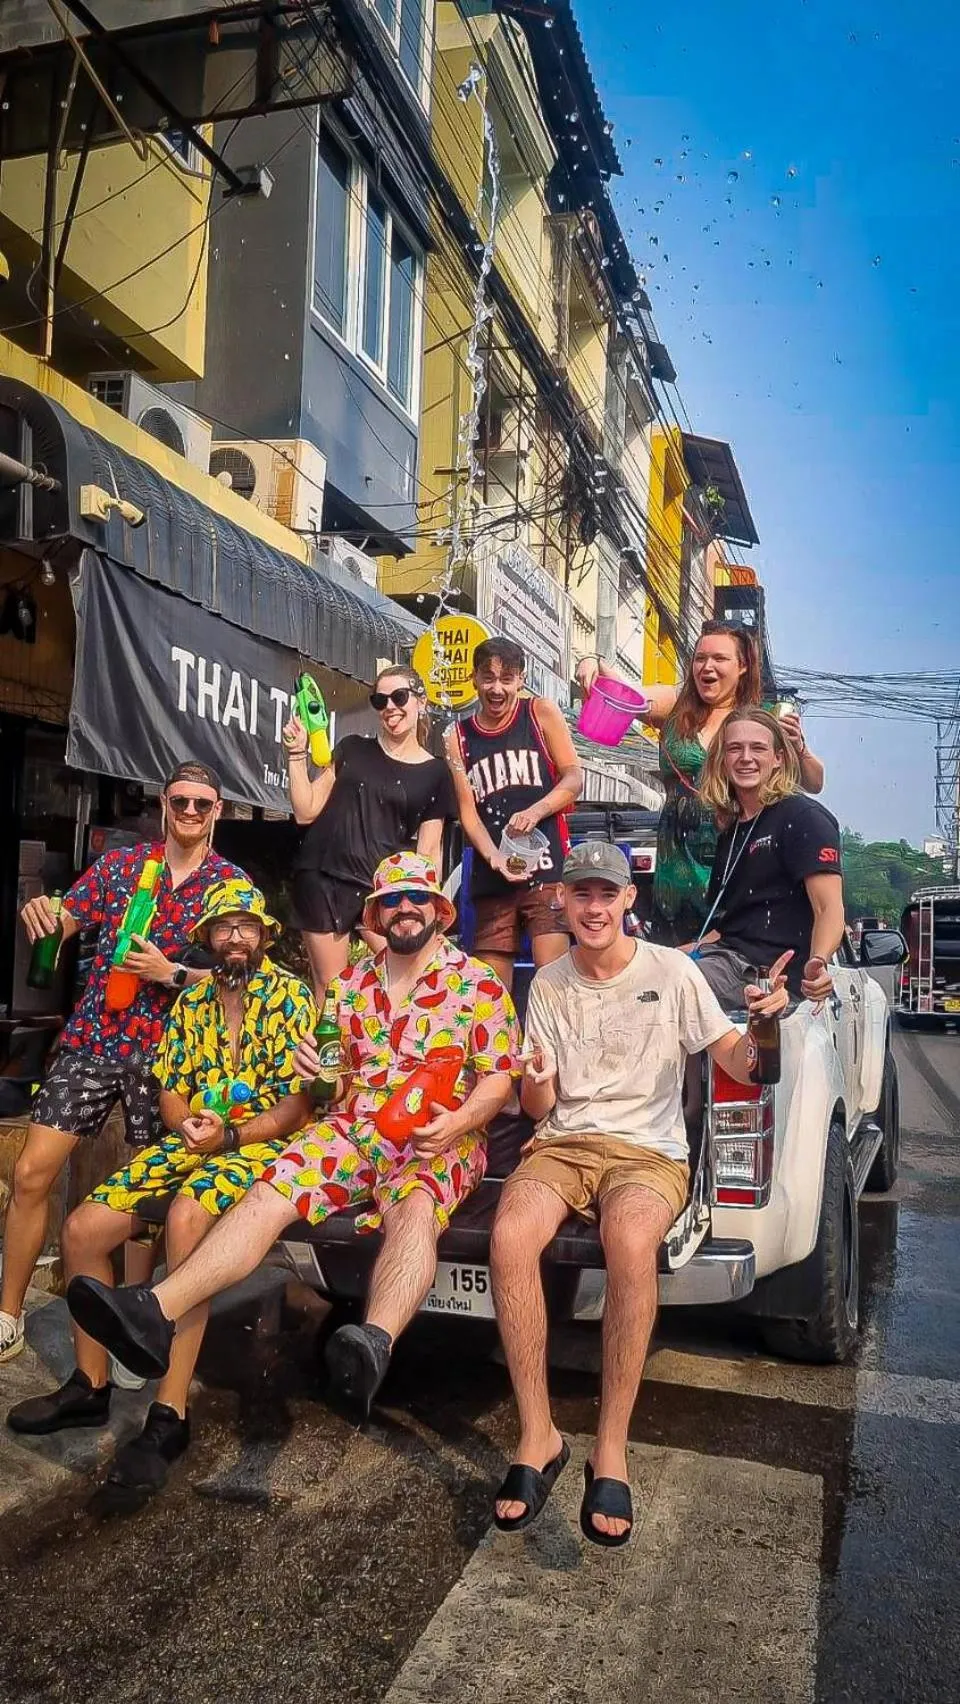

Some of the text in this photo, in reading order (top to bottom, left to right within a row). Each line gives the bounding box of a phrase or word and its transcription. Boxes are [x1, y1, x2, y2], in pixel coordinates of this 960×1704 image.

[433, 667, 468, 681] OSTEL
[171, 645, 336, 753] THAI TI
[450, 1267, 488, 1294] 155
